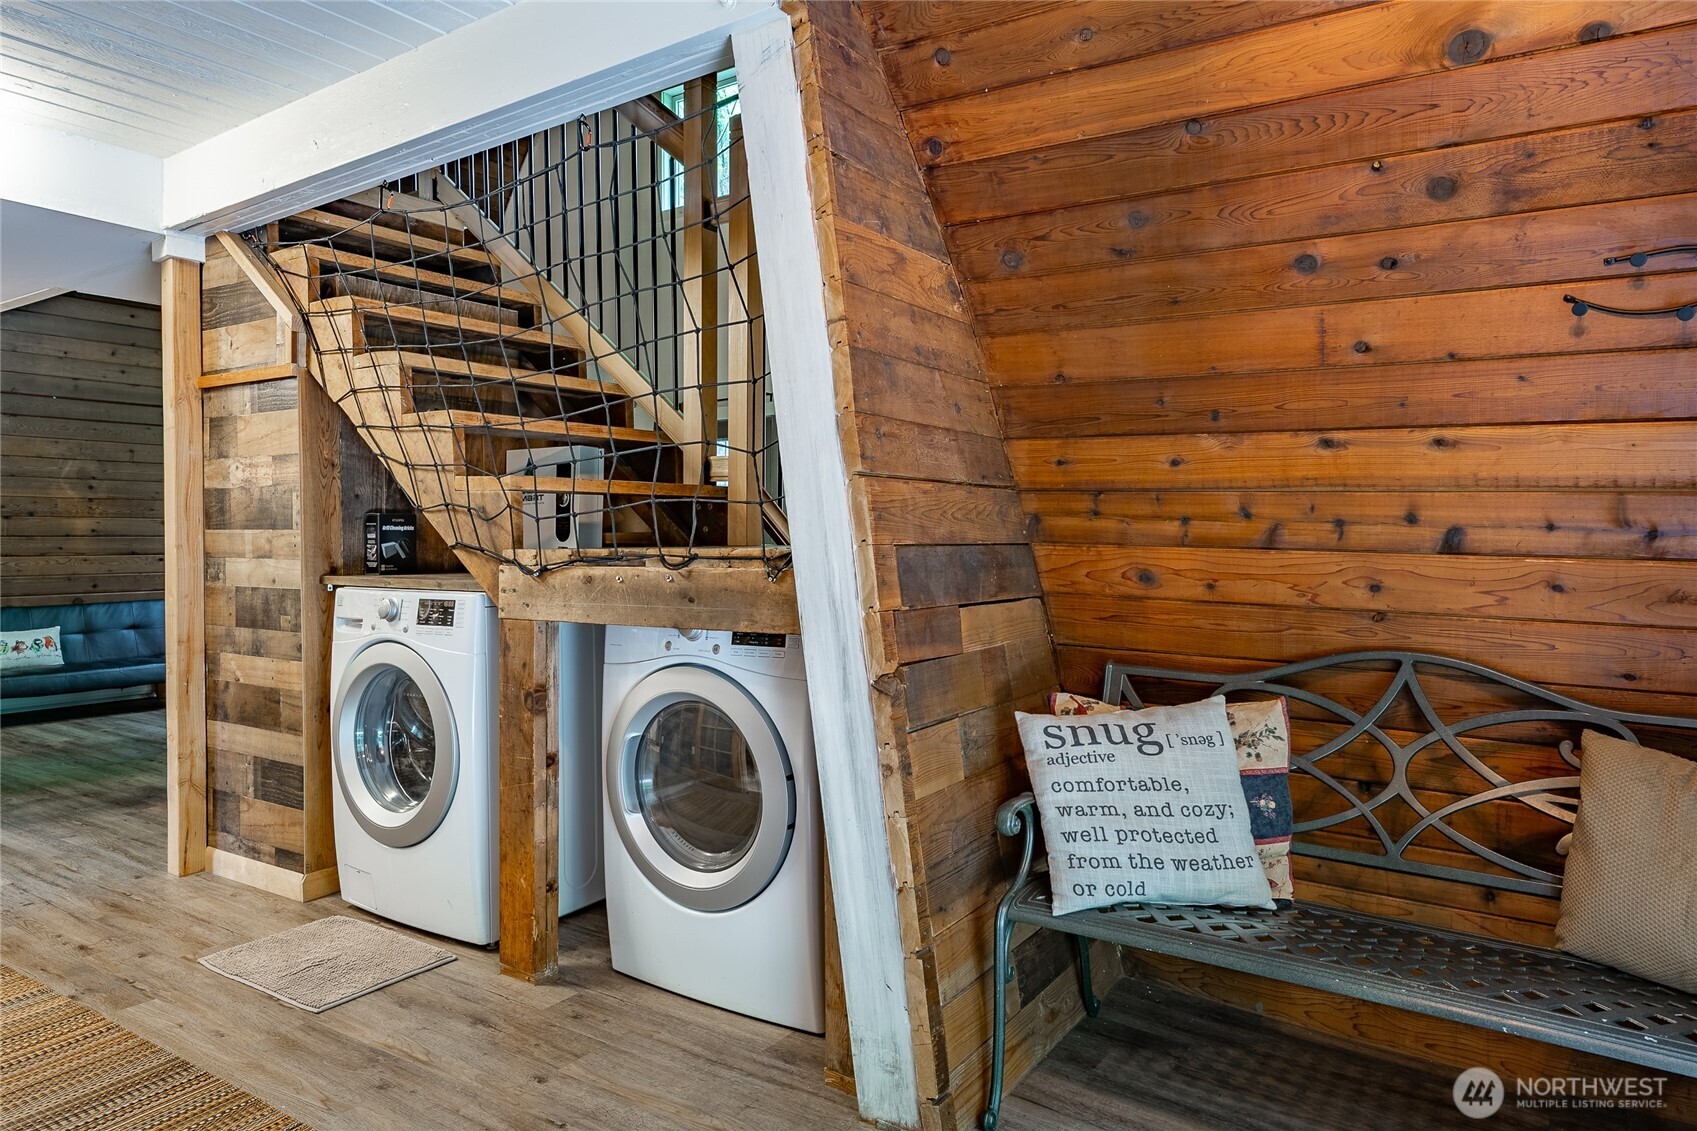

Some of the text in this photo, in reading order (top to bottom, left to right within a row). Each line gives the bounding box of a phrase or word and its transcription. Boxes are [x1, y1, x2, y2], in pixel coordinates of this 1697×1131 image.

[1043, 722, 1164, 756] snug
[1047, 751, 1116, 767] adjective
[1051, 777, 1190, 795] comfortable,
[1055, 803, 1235, 820] warm, and cozy;
[1060, 827, 1219, 845] well protected
[1067, 853, 1254, 872] from the weather
[1072, 880, 1146, 897] or cold
